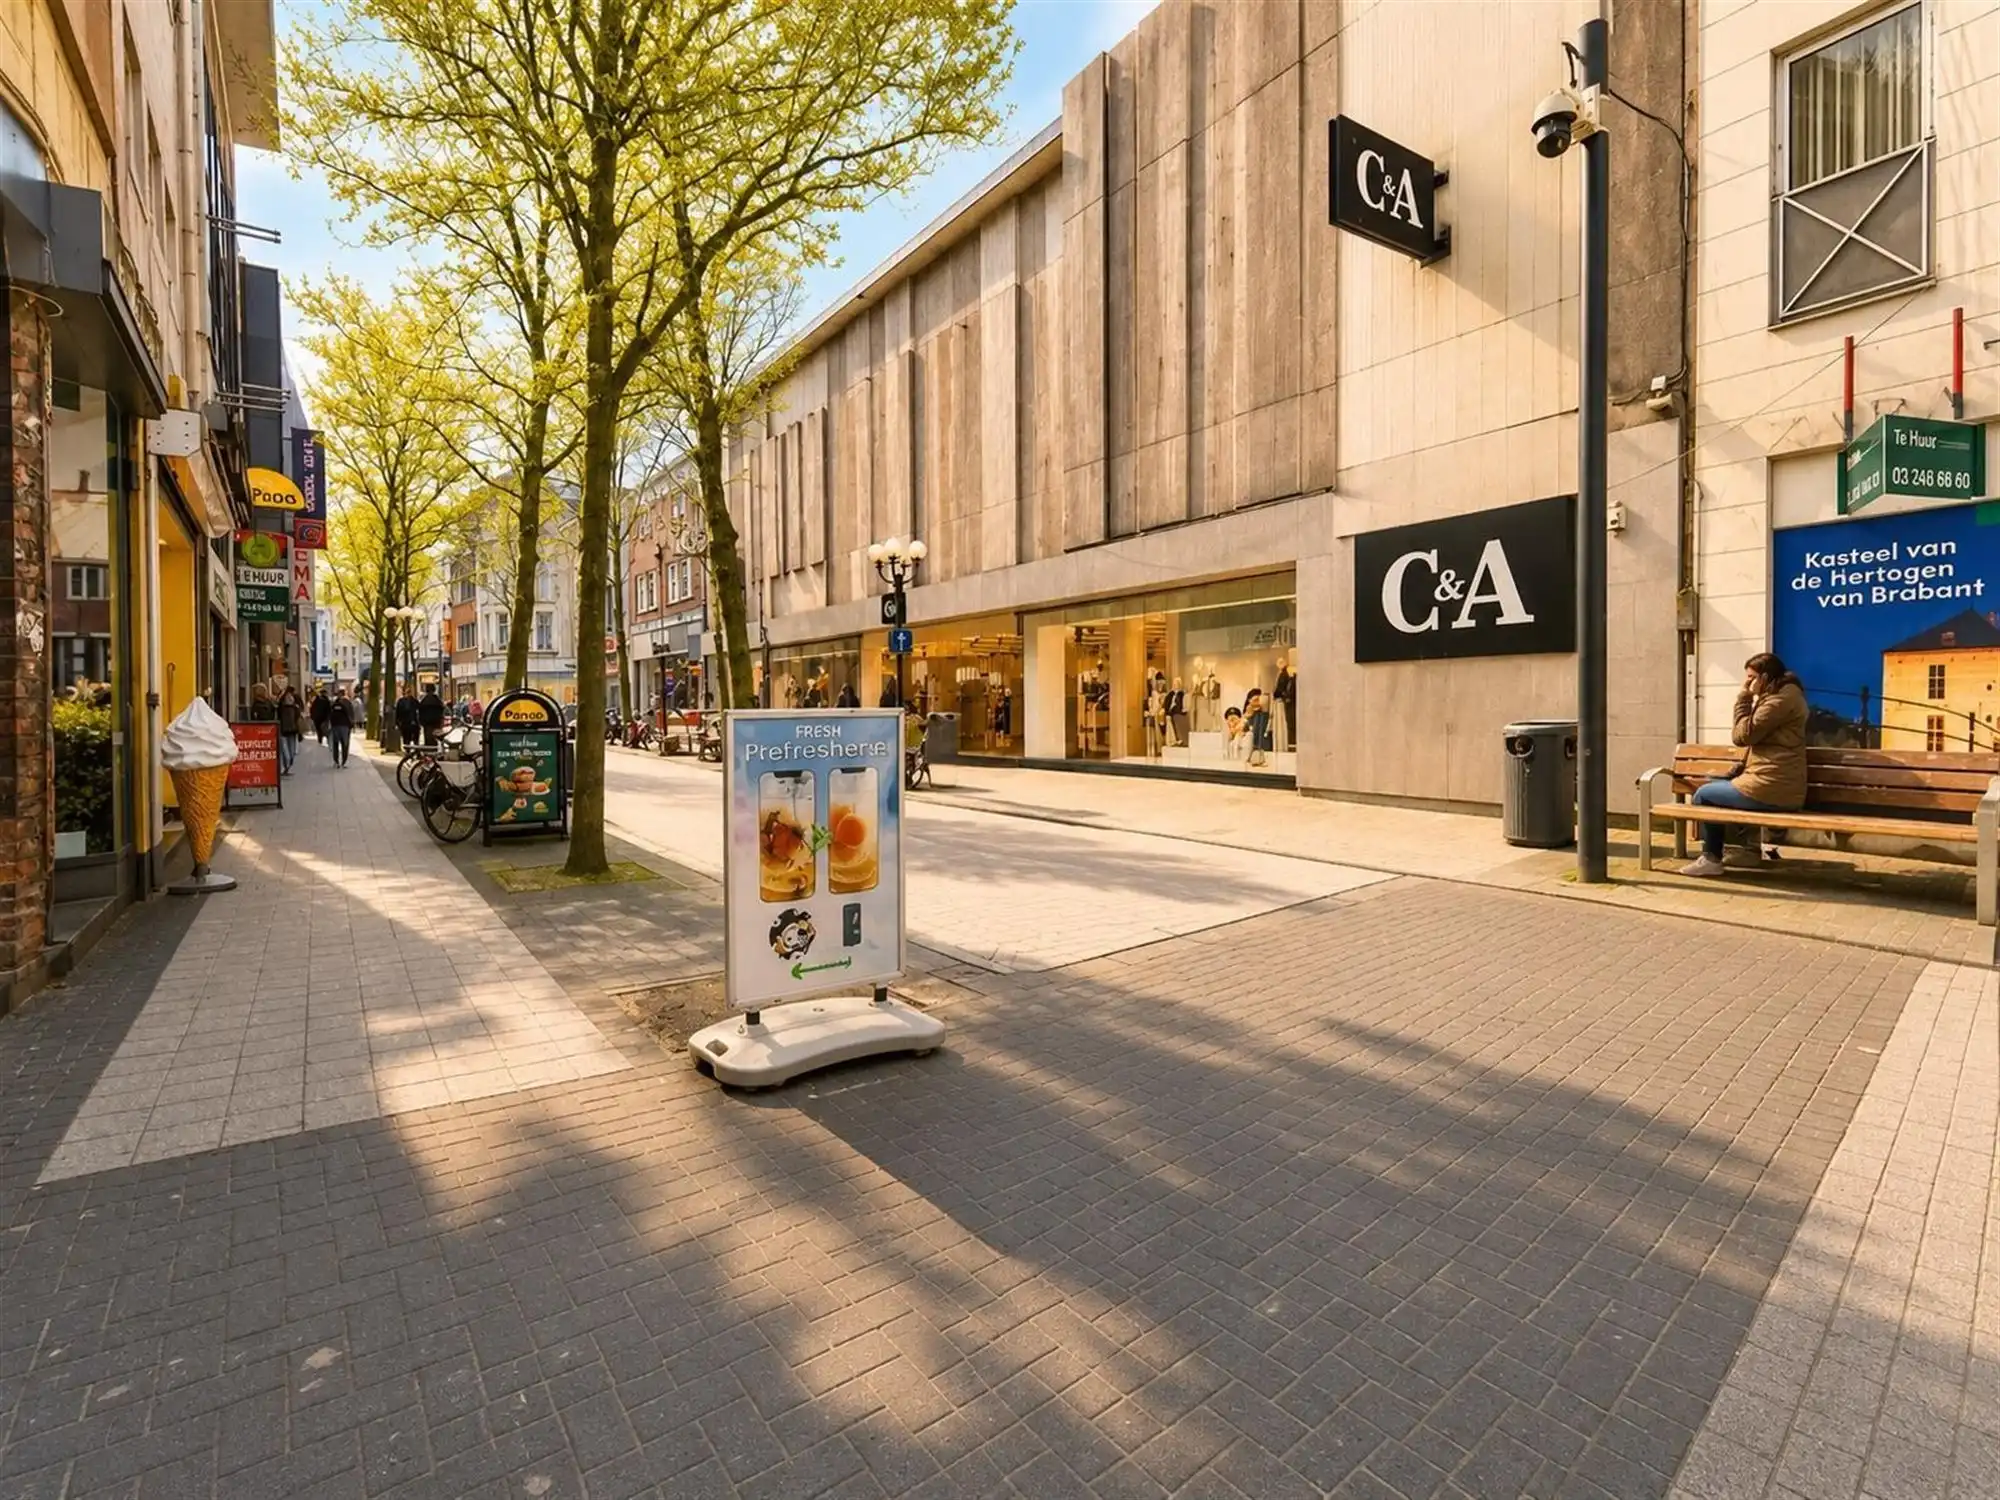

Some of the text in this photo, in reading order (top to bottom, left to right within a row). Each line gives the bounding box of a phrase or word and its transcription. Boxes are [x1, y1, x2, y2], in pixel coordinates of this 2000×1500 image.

[1356, 149, 1424, 229] C&A
[1893, 428, 1937, 449] Te Huur
[1892, 467, 1909, 486] 03
[1805, 541, 1956, 569] Kasteel van
[1381, 538, 1535, 634] C&A
[1791, 563, 1954, 590] de Hertogen
[1818, 579, 1985, 608] van Brabant
[795, 725, 841, 739] FRESH
